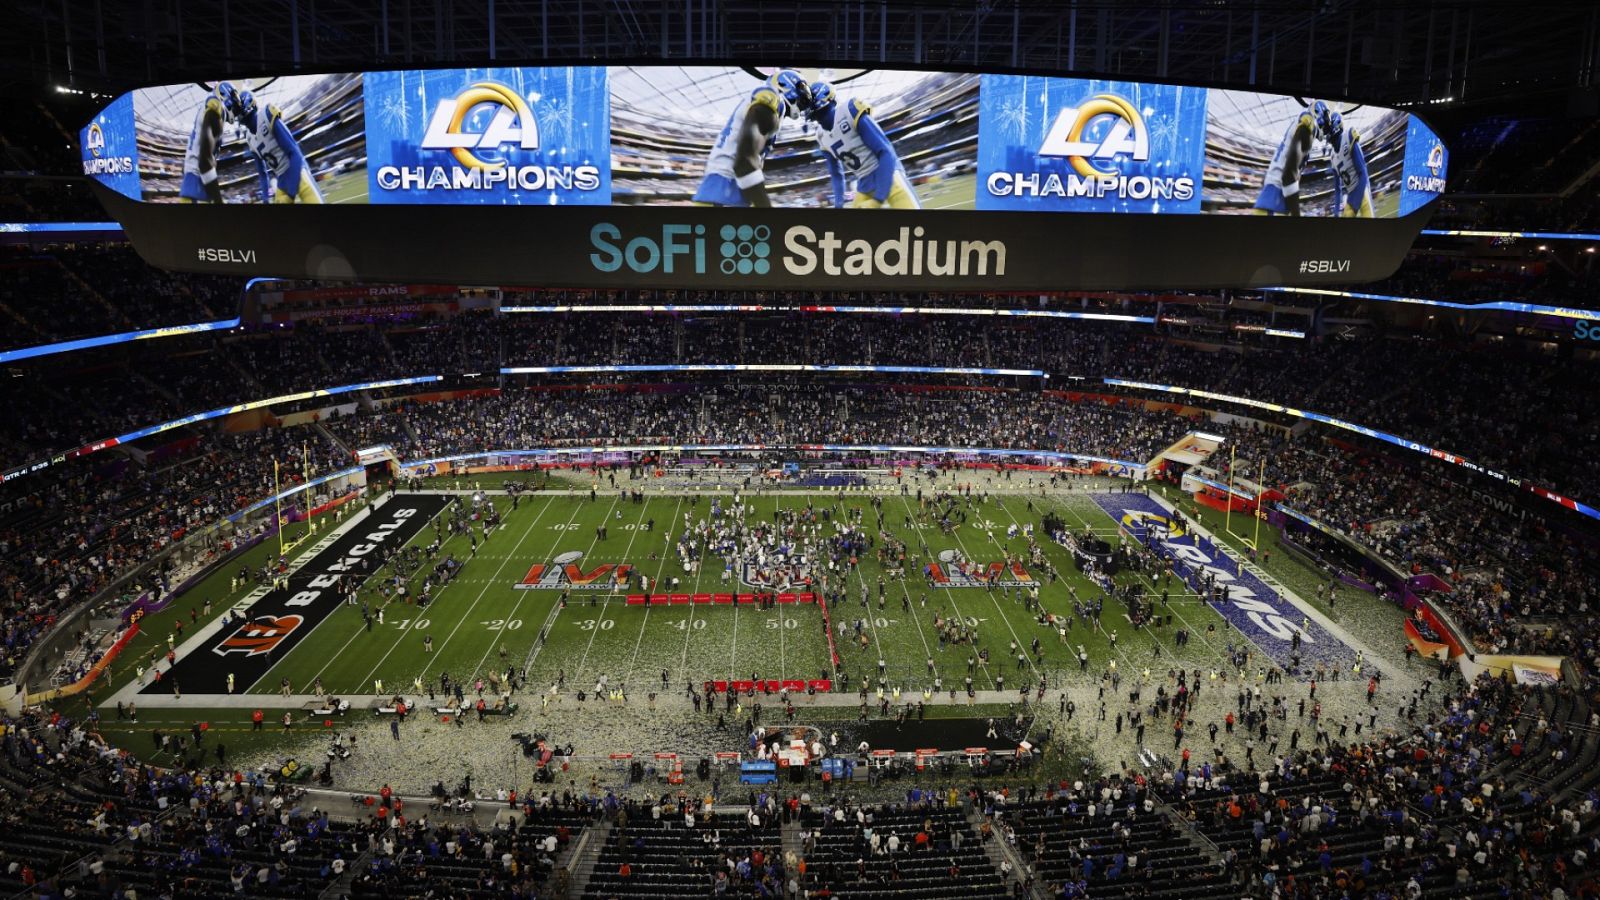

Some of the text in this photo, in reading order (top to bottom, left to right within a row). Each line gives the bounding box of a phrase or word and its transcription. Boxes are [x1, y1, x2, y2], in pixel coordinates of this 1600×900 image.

[377, 165, 600, 191] CHAMPIONS
[987, 171, 1194, 200] CHAMPIONS
[198, 248, 256, 265] #SBLVI
[591, 223, 1007, 276] SoFi Stadium
[1300, 259, 1351, 273] #SBLVI
[369, 286, 408, 296] RAMS
[284, 508, 417, 607] BENGALS
[1161, 542, 1314, 643] RAMS
[398, 618, 431, 630] 10
[487, 618, 523, 630] 20
[580, 619, 615, 631] 30
[674, 619, 707, 630] 40
[765, 618, 798, 630] 50
